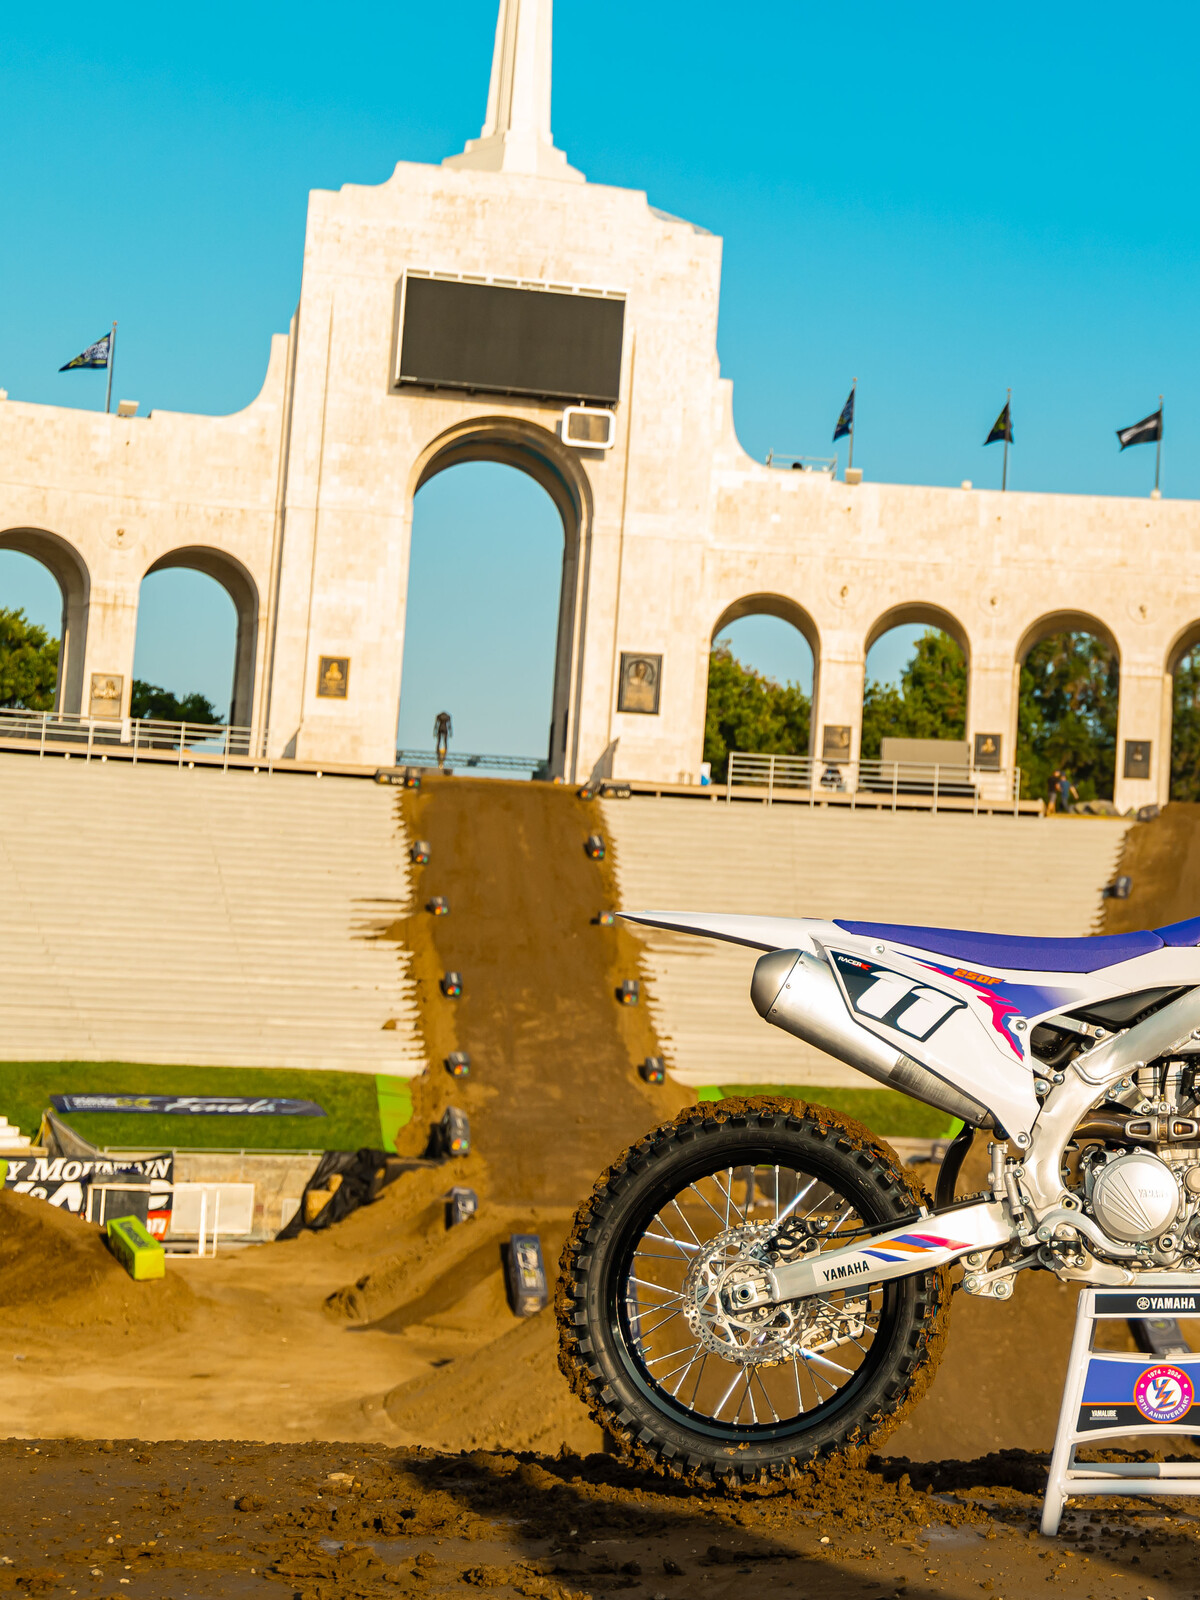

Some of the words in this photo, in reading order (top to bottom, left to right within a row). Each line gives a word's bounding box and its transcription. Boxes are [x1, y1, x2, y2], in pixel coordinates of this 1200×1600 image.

[953, 968, 1003, 985] 250F
[822, 1260, 870, 1281] YAMAHA
[1150, 1297, 1196, 1309] YAMAHA
[1147, 1368, 1162, 1379] 1974
[1167, 1368, 1181, 1379] 2024
[1148, 1394, 1190, 1419] ANNIVERSARY
